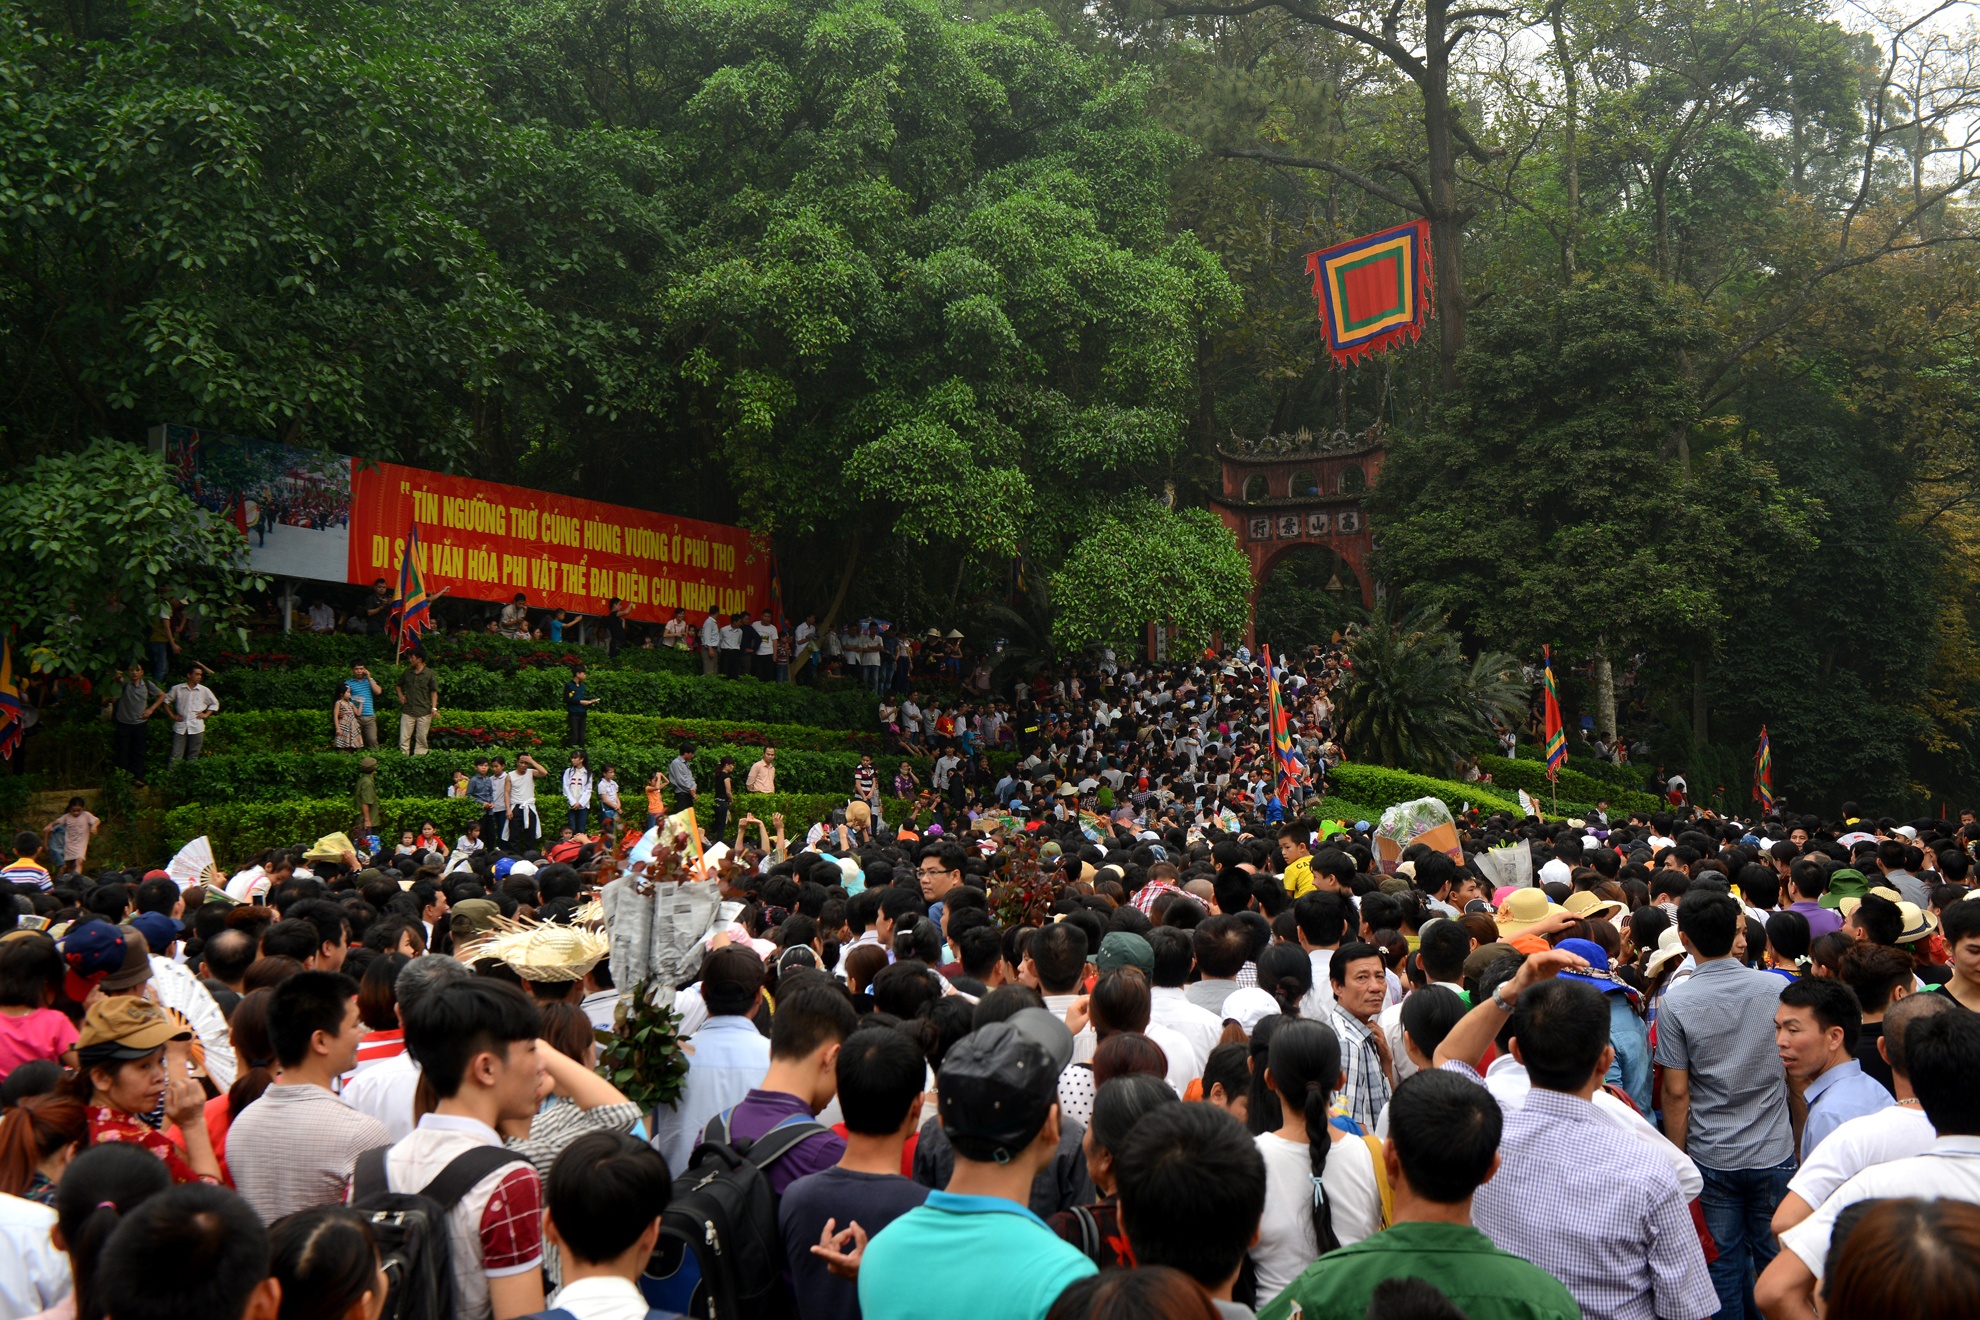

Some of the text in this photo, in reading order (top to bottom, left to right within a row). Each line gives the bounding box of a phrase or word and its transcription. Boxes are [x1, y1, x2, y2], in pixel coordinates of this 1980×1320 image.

[372, 534, 389, 569] DI
[394, 537, 428, 574] SN
[432, 538, 464, 578] VĂN
[467, 544, 499, 583] HÓA
[502, 554, 527, 587] PHI
[531, 553, 559, 597] VẬT
[561, 554, 588, 596] THỂ
[590, 567, 613, 605] ĐẠI
[617, 568, 649, 609] DIỆN
[651, 566, 678, 609] CỦA
[681, 578, 716, 613] NHÂN
[442, 493, 506, 536] NGƯỠNG
[510, 502, 539, 541] THỜ
[541, 508, 580, 548] CÚNG
[584, 515, 621, 555] HÙNG
[624, 526, 669, 563] VƯƠNG
[672, 523, 681, 564] Ở
[684, 535, 709, 569] PHÚ
[712, 542, 736, 579] THỌ
[1296, 861, 1311, 869] CA
